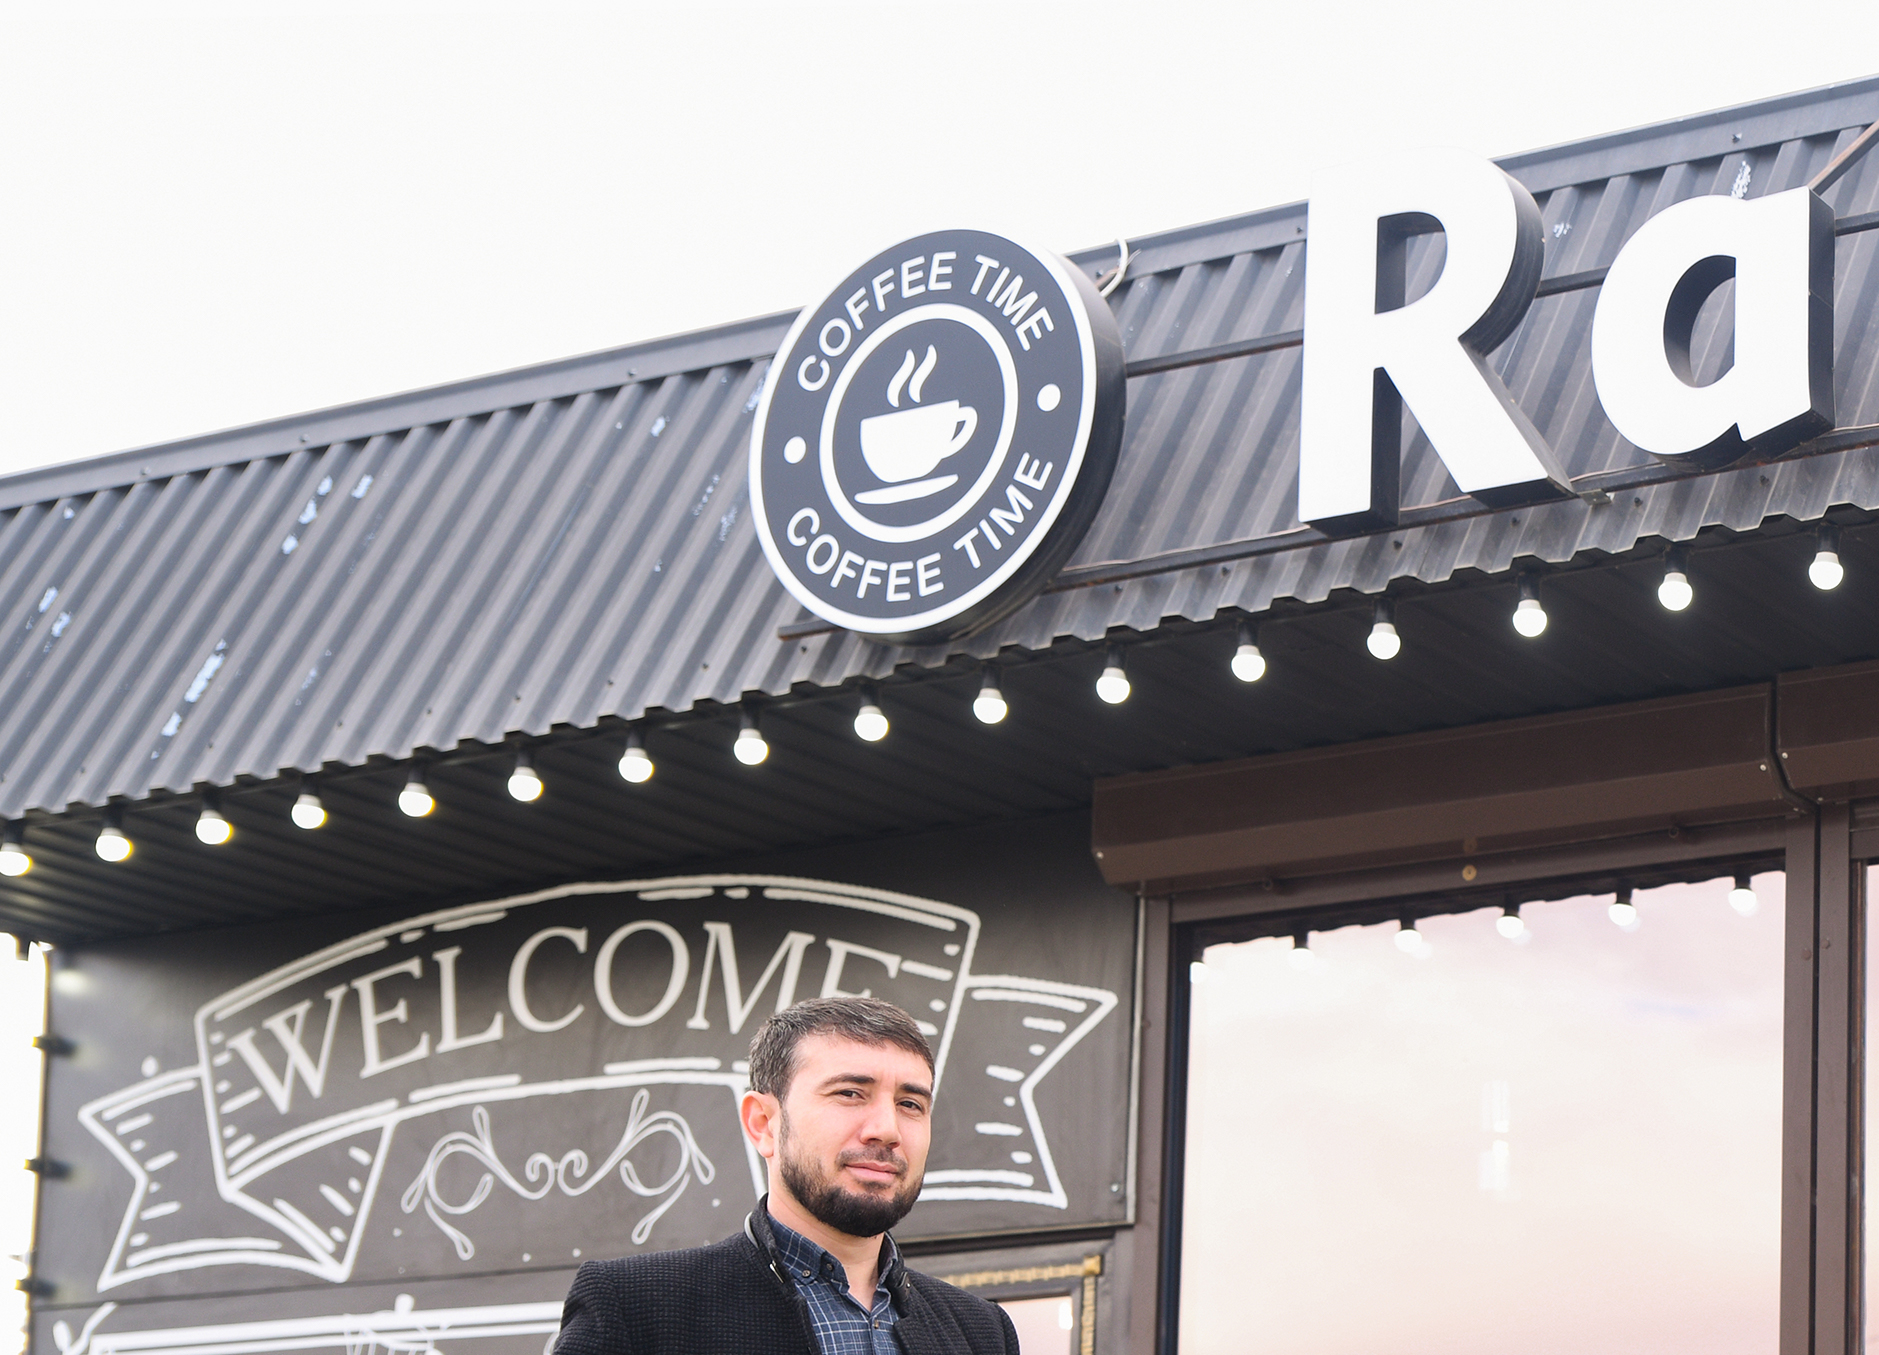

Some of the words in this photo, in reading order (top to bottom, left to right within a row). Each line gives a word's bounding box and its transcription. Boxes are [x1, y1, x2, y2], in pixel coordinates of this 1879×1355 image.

[797, 251, 957, 391] COFFEE
[969, 253, 1055, 351] TIME
[786, 507, 944, 602] COFFEE
[952, 451, 1053, 569] TIME
